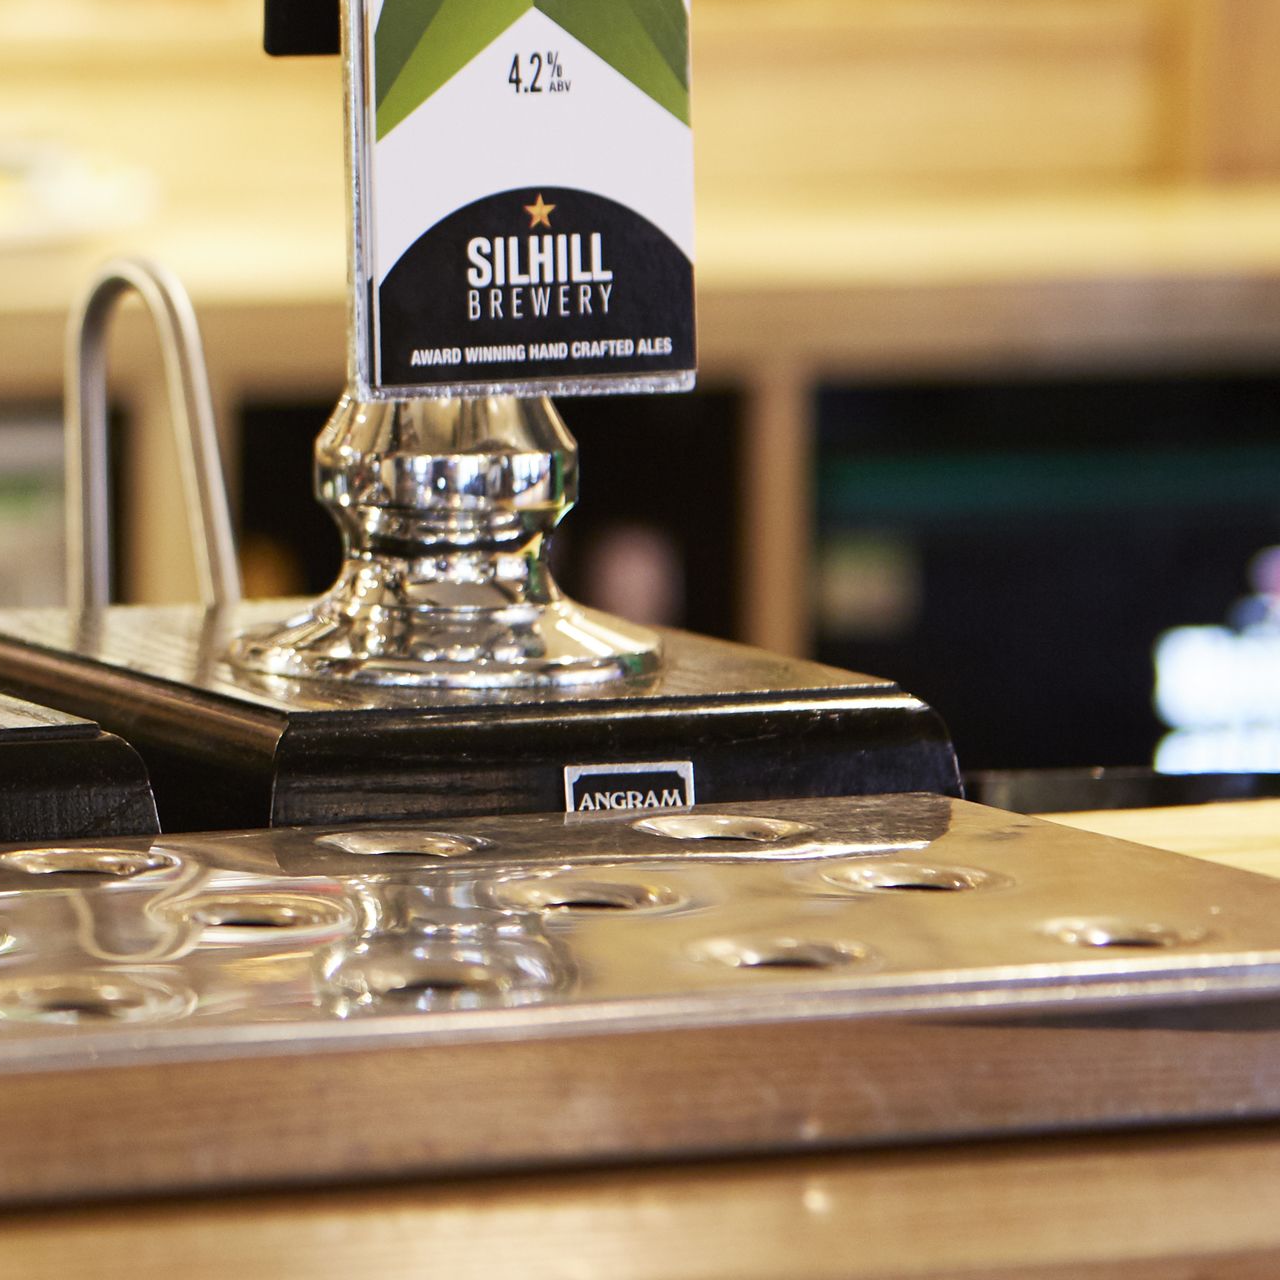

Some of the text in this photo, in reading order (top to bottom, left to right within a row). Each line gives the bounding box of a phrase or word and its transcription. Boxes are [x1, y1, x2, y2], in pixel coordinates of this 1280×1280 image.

[508, 51, 572, 93] 4.2% ABV
[466, 231, 614, 288] SILHILL
[467, 283, 614, 320] BREWERY
[410, 336, 673, 366] AWARD WINNING HAND CRAFTED ALES
[578, 788, 683, 812] ANGRAM
